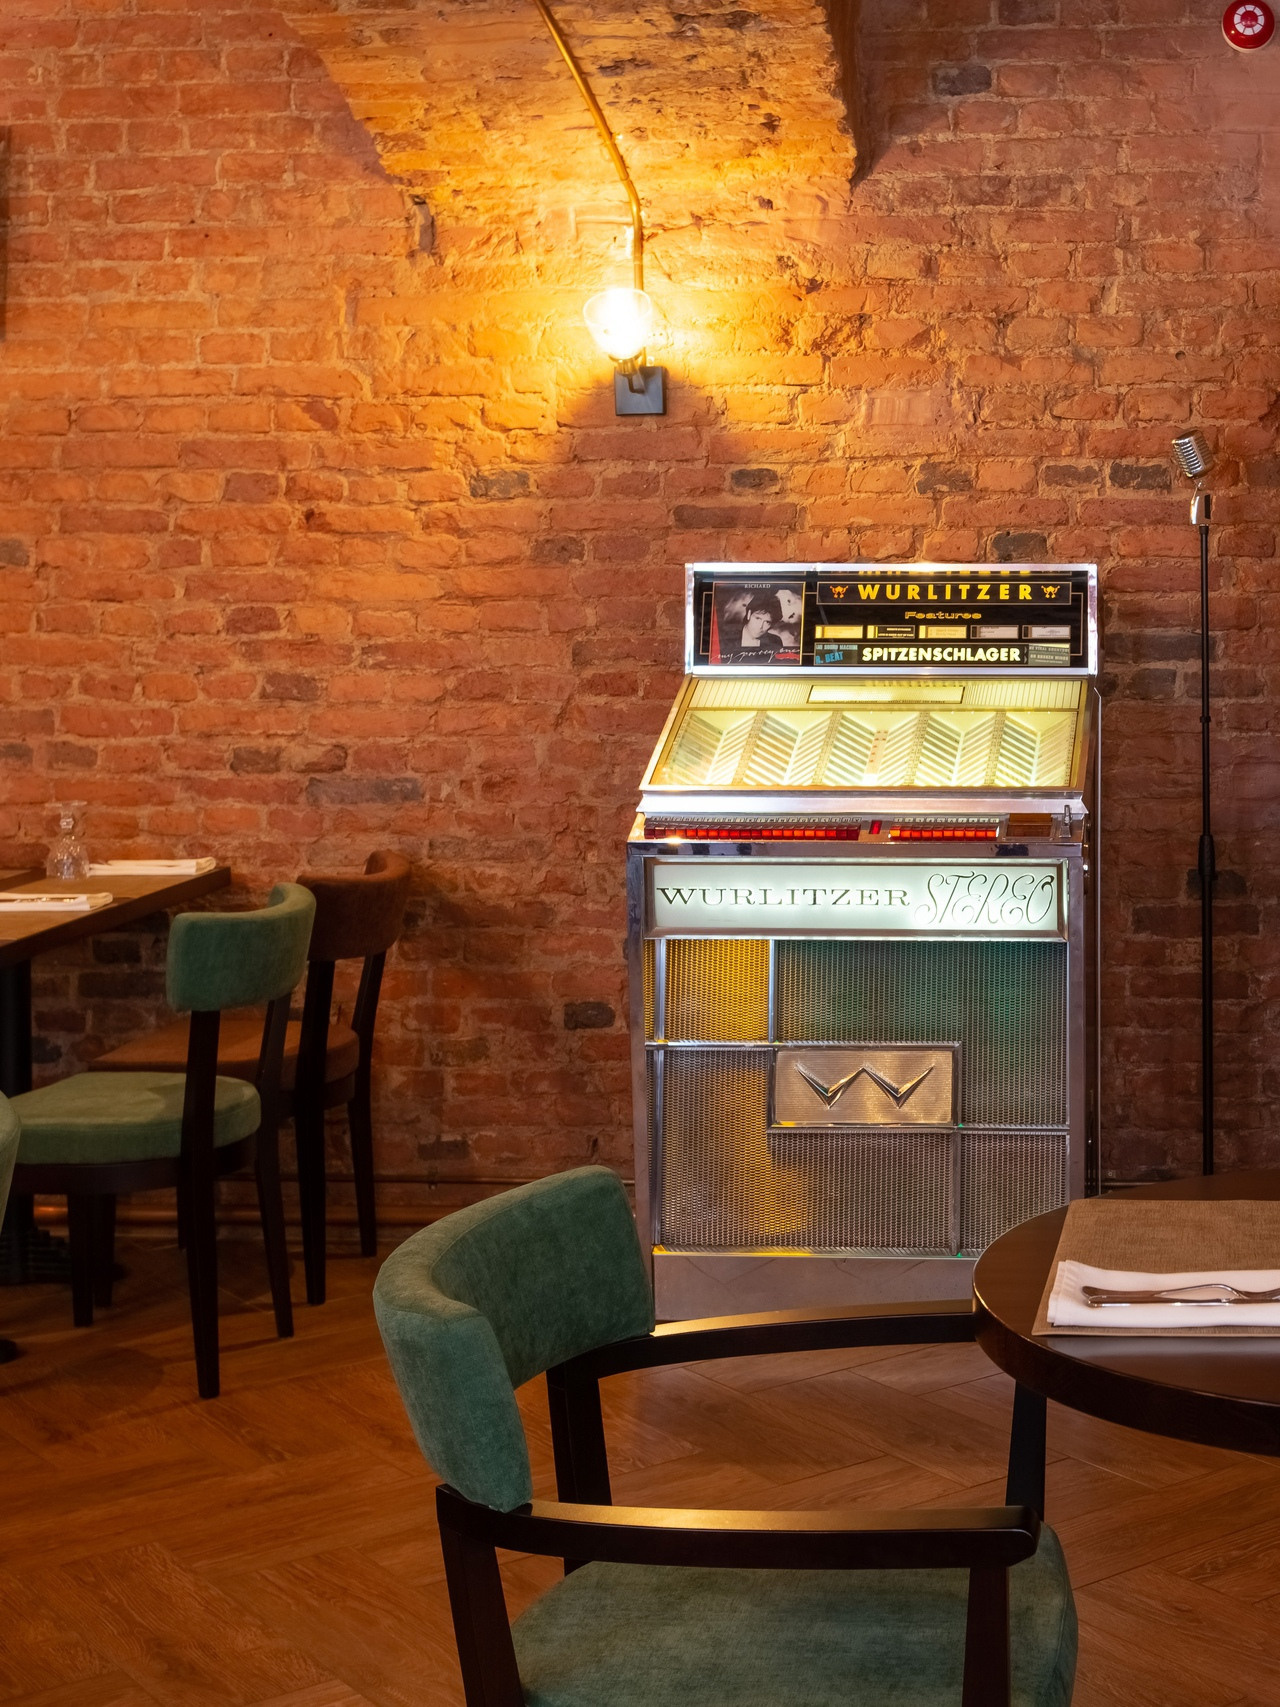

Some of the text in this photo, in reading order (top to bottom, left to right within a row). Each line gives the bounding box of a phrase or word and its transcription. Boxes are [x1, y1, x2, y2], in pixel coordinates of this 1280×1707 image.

[858, 584, 1033, 600] WURLITZER
[904, 611, 982, 620] Features
[825, 651, 844, 663] BEAT
[862, 647, 1021, 662] SPITZENSCHLAGER
[656, 870, 1055, 925] WURLITZER STEREO
